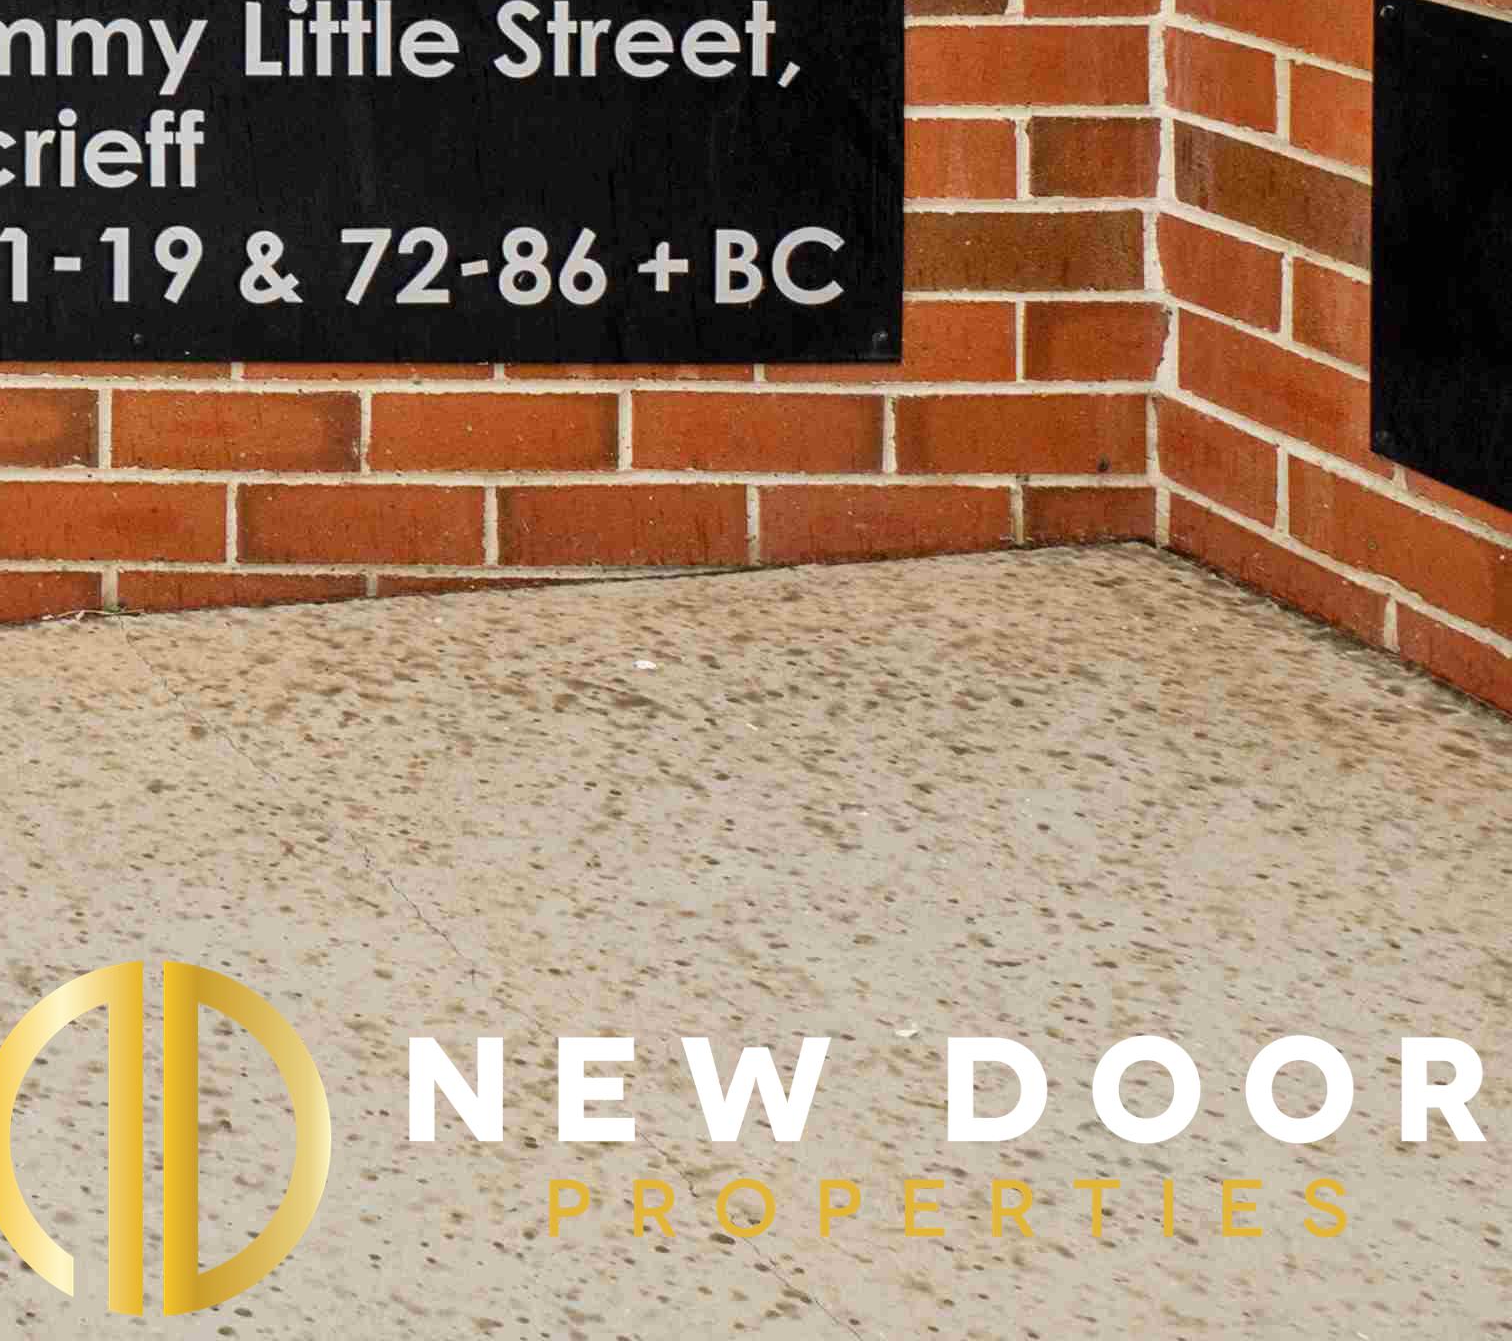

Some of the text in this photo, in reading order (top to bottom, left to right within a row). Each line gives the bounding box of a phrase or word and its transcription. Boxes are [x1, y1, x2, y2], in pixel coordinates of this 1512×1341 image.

[494, 0, 800, 87] Street,
[240, 231, 303, 303] &
[341, 227, 606, 305] 72-86
[715, 227, 844, 304] BC
